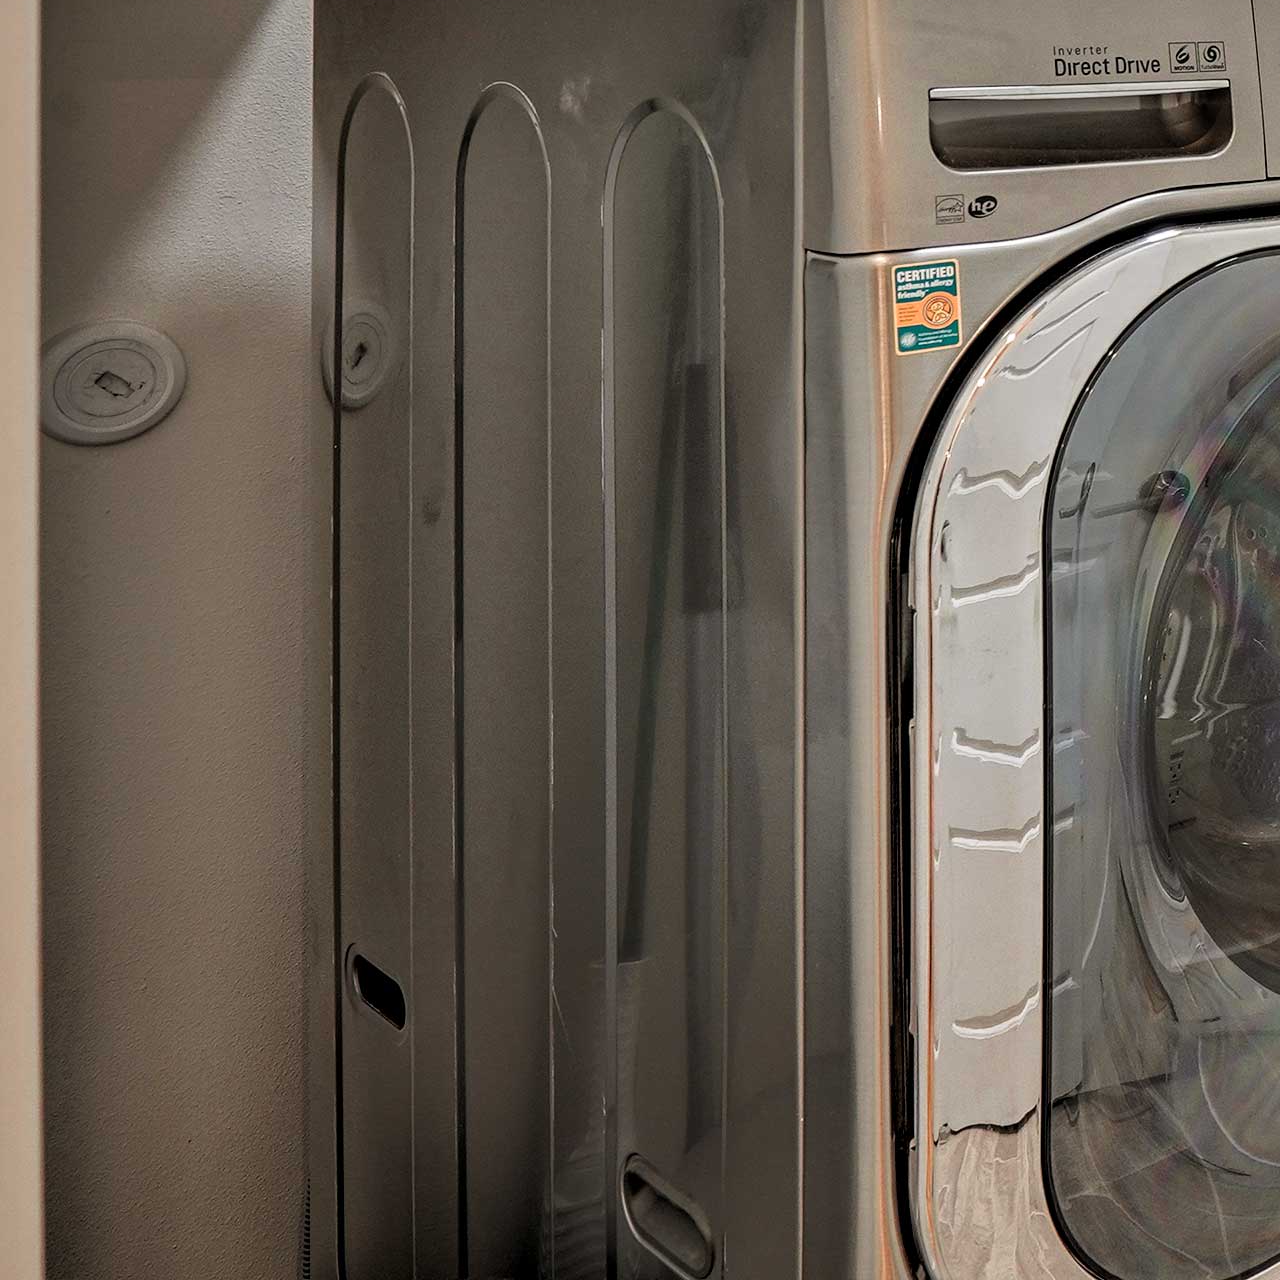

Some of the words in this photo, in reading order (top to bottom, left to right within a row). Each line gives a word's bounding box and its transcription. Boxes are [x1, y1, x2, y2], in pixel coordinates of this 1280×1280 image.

[1053, 46, 1109, 56] Inverter
[1054, 57, 1110, 77] Direct
[1114, 56, 1161, 74] Drive
[896, 265, 955, 283] CERTIFIED
[897, 282, 925, 291] asthma
[930, 278, 955, 287] allergy
